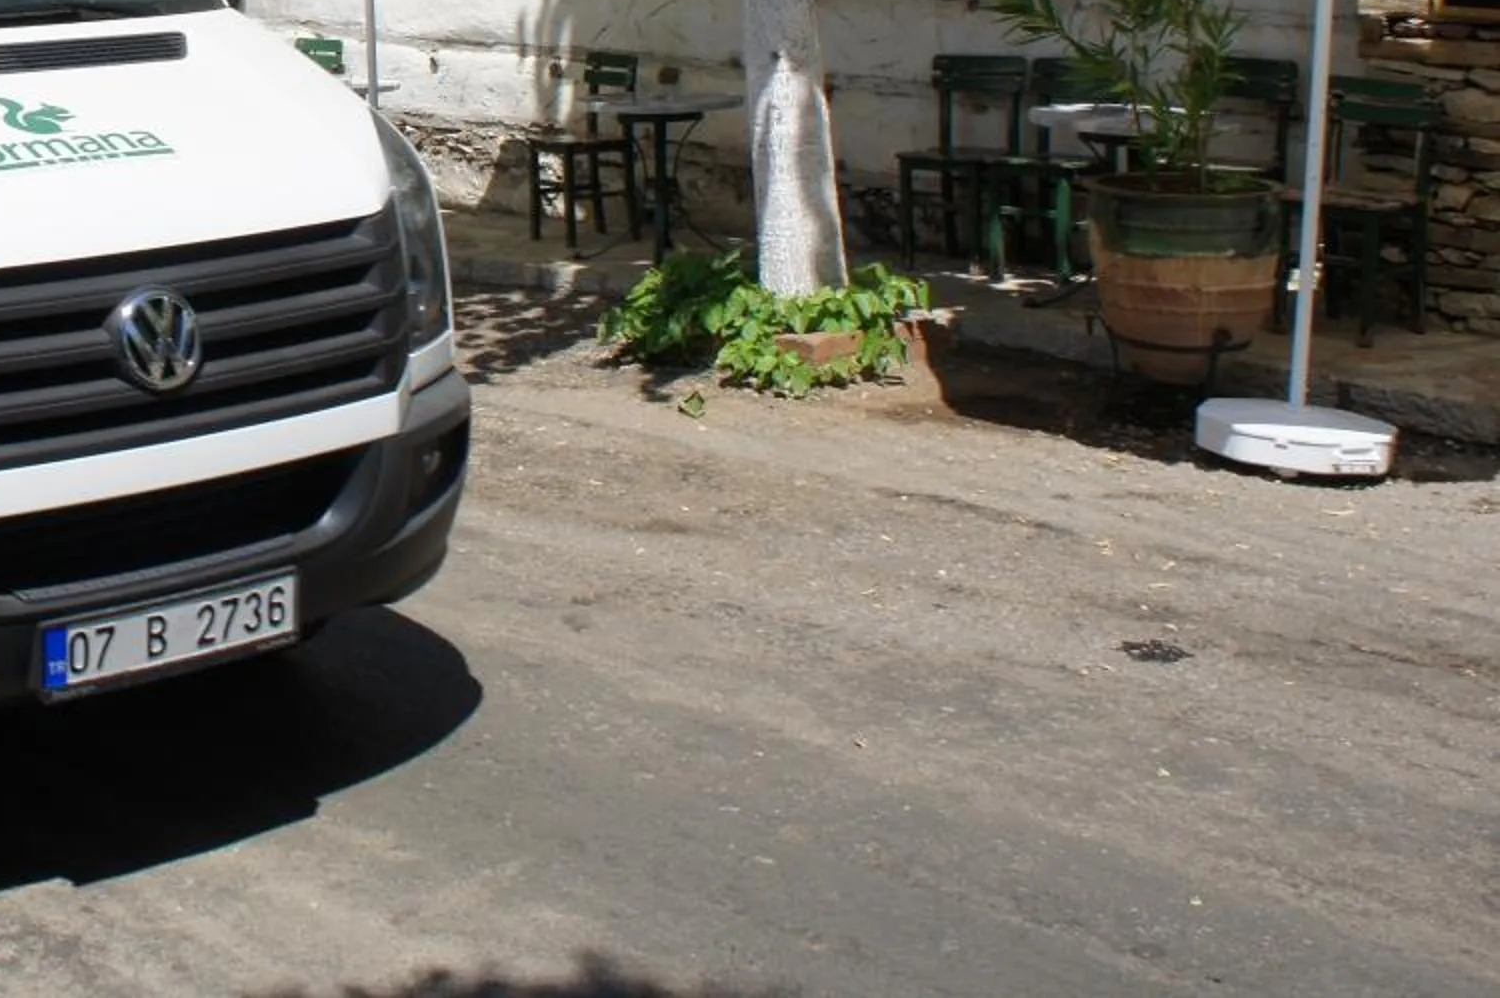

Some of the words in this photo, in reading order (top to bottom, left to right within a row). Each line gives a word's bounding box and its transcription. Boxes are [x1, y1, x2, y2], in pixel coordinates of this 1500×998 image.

[69, 625, 116, 674] 07
[147, 615, 168, 658] B
[197, 585, 286, 648] 2736
